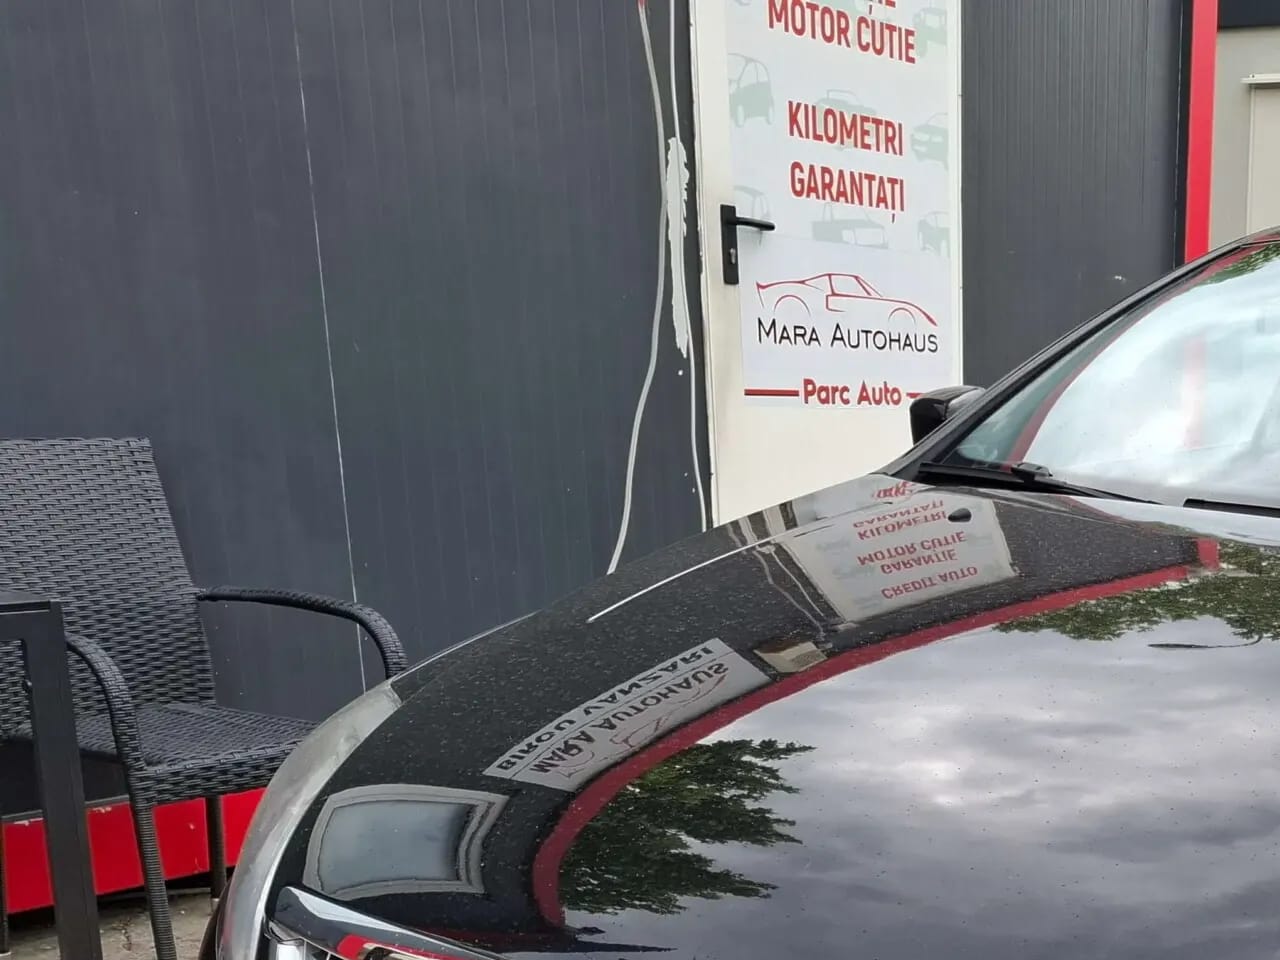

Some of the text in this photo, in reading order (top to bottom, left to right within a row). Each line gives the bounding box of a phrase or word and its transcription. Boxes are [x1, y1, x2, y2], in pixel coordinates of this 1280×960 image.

[768, 0, 916, 64] MOTOR CUTIE
[788, 100, 903, 156] KILOMETRI
[790, 161, 904, 223] GARANTAȚI
[757, 317, 938, 353] MARA AUTOHAUS
[803, 378, 902, 406] Parc Auto
